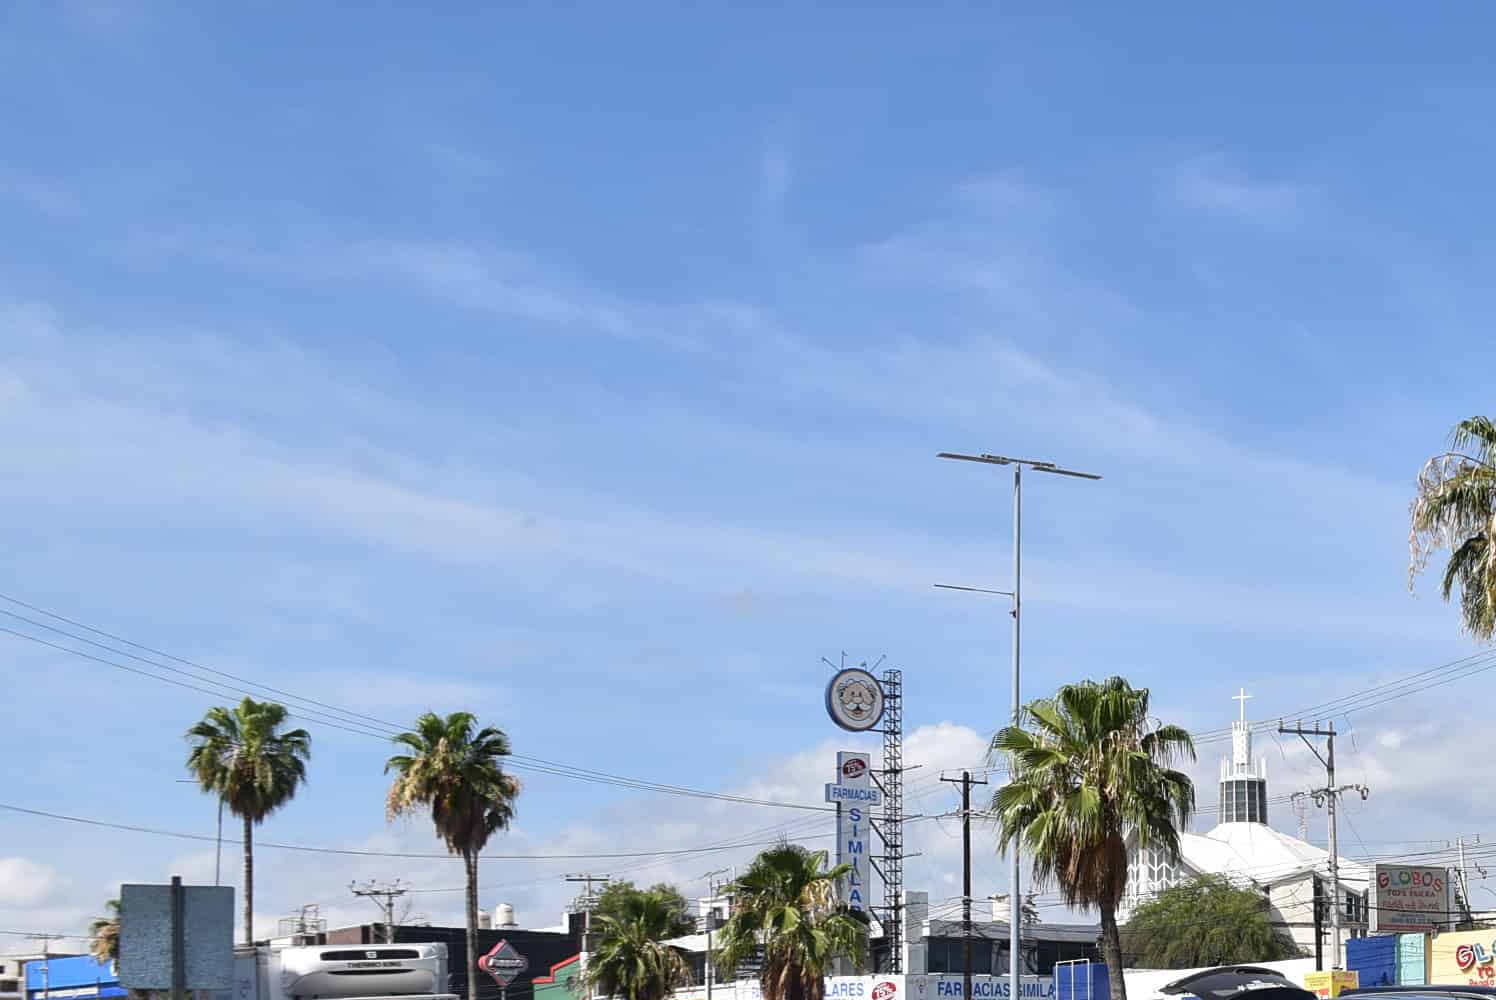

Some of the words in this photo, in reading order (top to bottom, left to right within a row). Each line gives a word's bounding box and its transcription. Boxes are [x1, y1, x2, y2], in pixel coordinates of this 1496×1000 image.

[832, 787, 877, 801] FARMACIAS
[848, 808, 863, 912] SIMILA
[1378, 871, 1442, 892] GLOBOS
[937, 982, 1011, 998] FARACIAS
